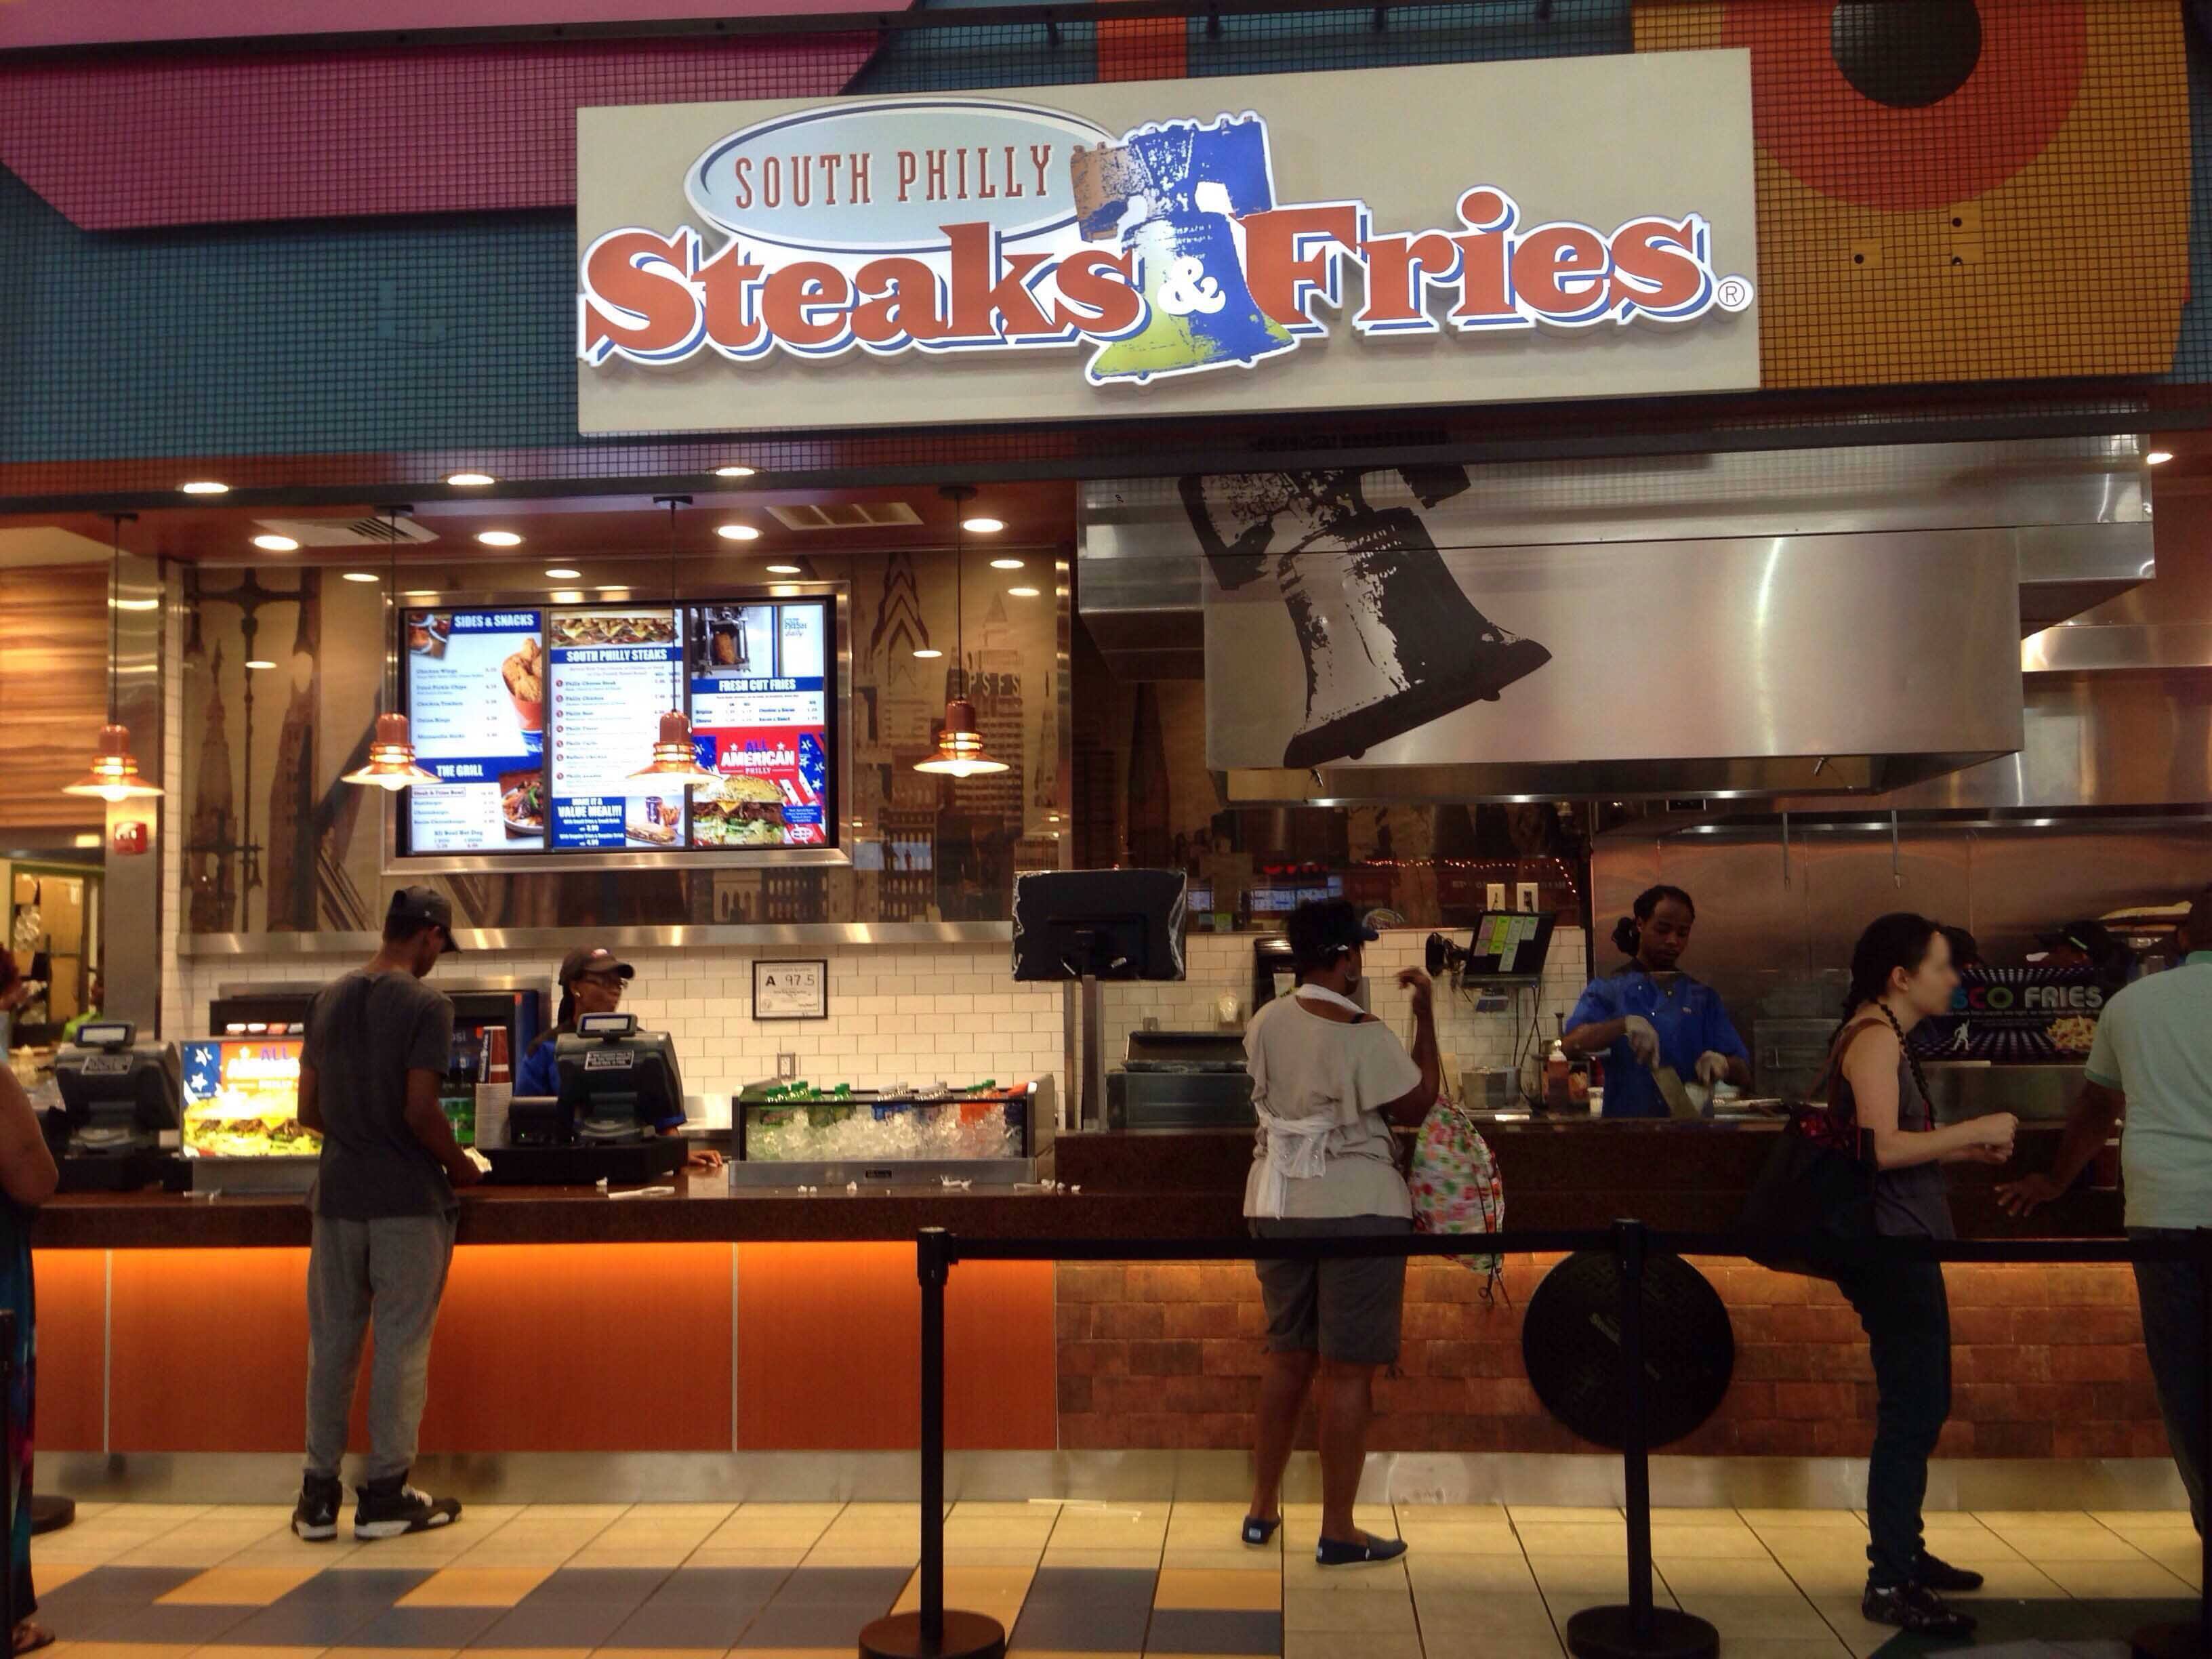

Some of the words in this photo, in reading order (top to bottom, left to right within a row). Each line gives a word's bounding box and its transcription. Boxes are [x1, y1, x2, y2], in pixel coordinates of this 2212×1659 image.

[735, 152, 873, 209] SOUTH
[897, 144, 1052, 203] PHILLY
[585, 221, 1144, 355] Steaks
[1158, 256, 1227, 316] &
[1230, 190, 1704, 327] Fries
[455, 615, 483, 628] SIDES
[493, 614, 534, 627] SNACKS
[567, 651, 598, 662] SOUTH
[600, 650, 630, 661] PHILLY
[631, 649, 667, 660] STEAKS
[719, 679, 748, 691] FRESH
[750, 679, 769, 691] CUT
[770, 678, 796, 691] FRIES
[968, 672, 1021, 697] PSFS
[720, 751, 795, 766] AMERICAN
[436, 765, 455, 777] THE
[456, 764, 484, 777] GRILL
[557, 806, 587, 818] VALUE
[765, 975, 776, 986] A
[1952, 986, 2014, 1010] SCO
[2024, 985, 2103, 1008] FRIES
[261, 1046, 289, 1060] ALL
